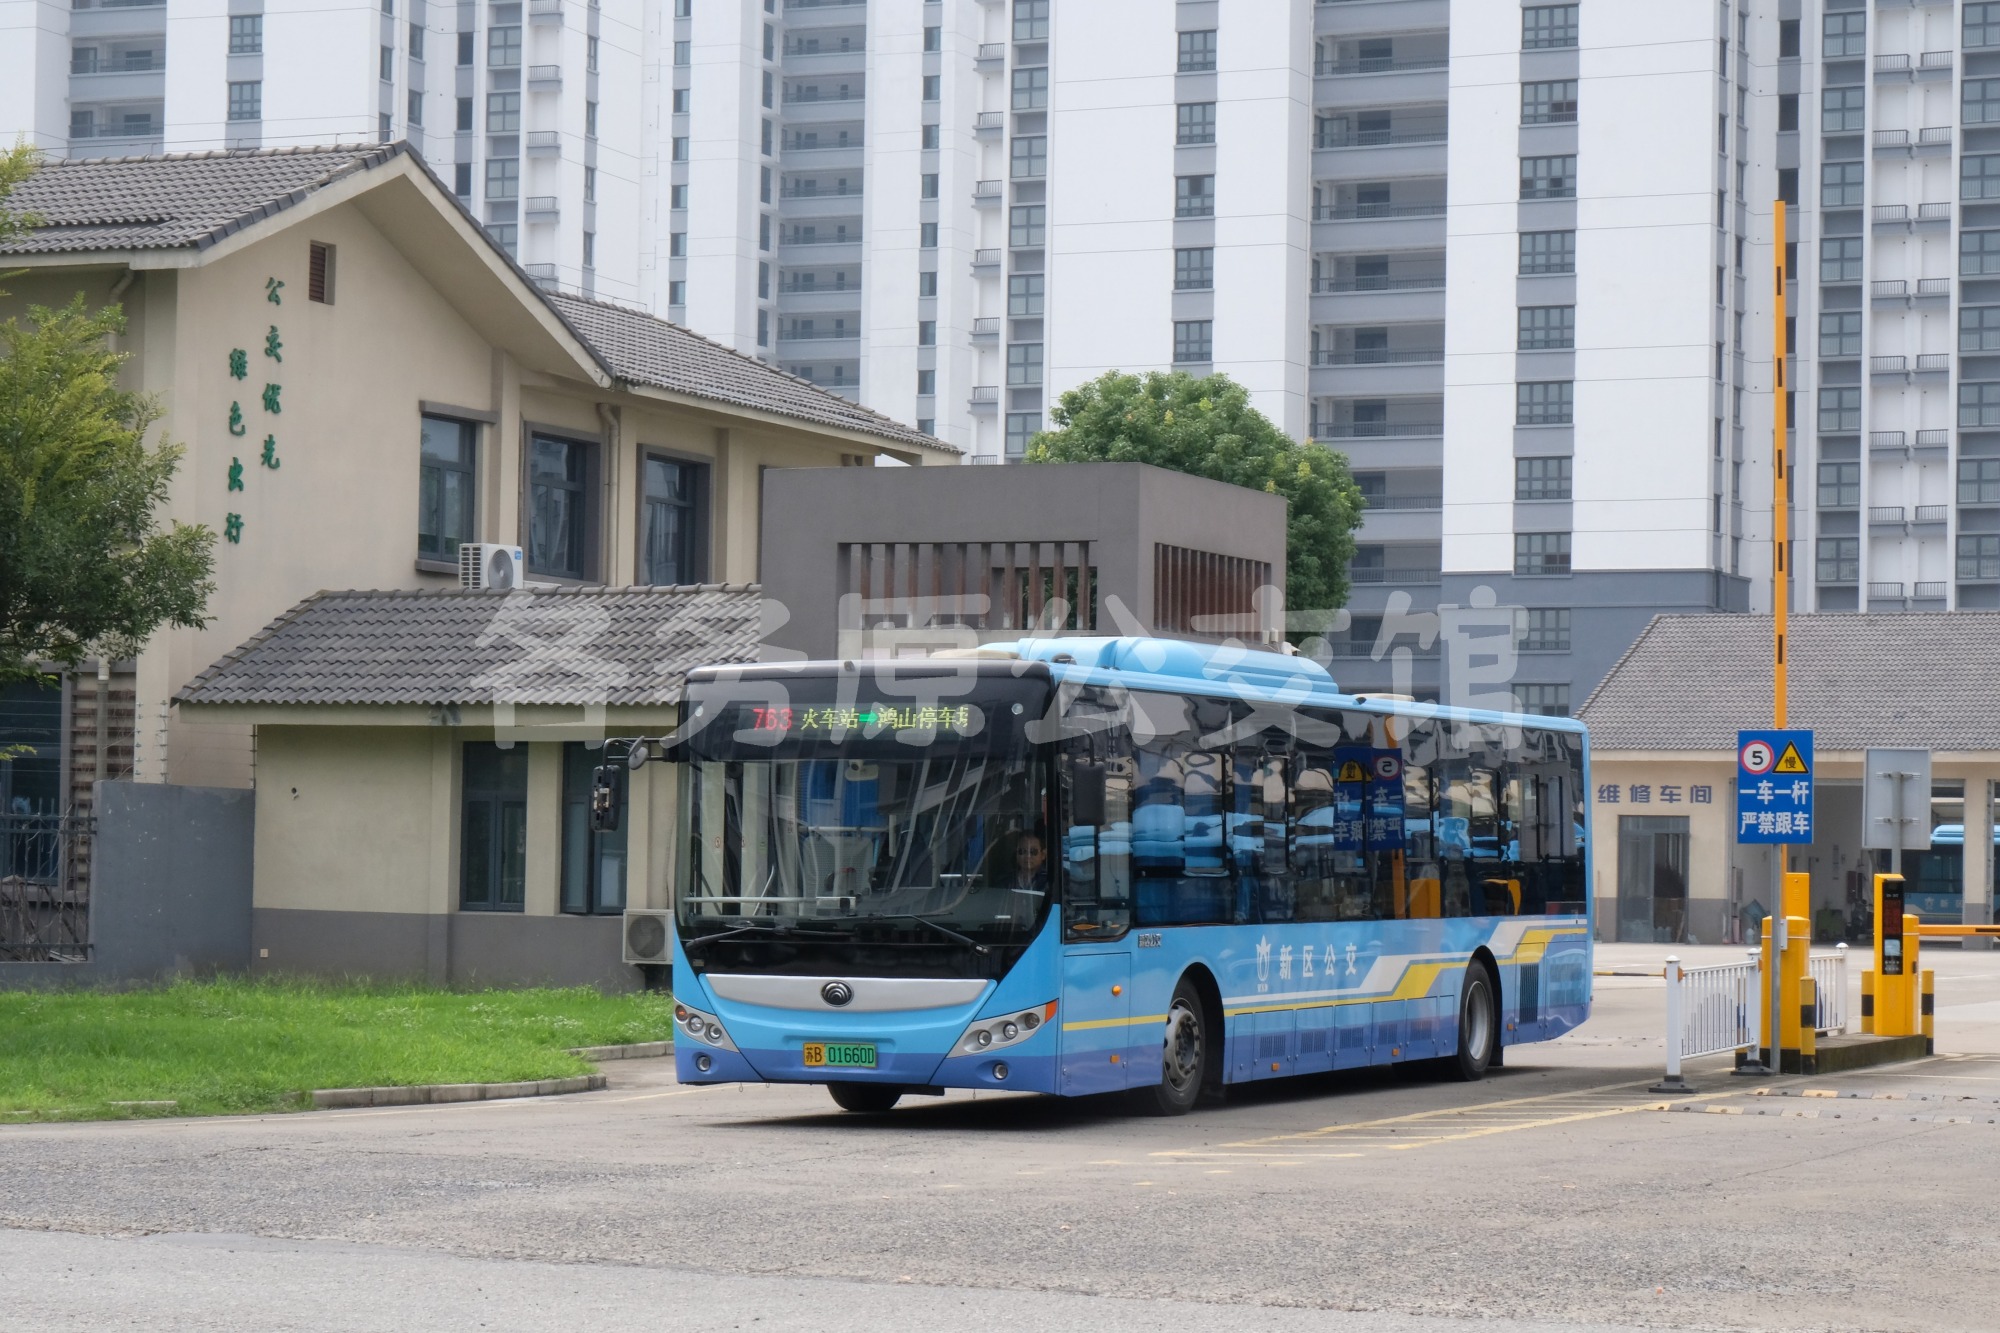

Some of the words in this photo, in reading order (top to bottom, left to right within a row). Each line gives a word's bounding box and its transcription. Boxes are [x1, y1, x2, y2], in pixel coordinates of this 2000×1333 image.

[262, 277, 285, 469] 公交优先
[224, 348, 248, 543] 绿色出行
[752, 708, 793, 731] 763
[801, 708, 860, 730] 火车站
[1752, 751, 1763, 765] 5
[1784, 757, 1796, 769] 慢
[1598, 784, 1712, 804] 维修车间
[1739, 780, 1810, 805] 一车一杆
[1740, 811, 1810, 835] 严禁跟车
[1279, 942, 1357, 980] 新区公交
